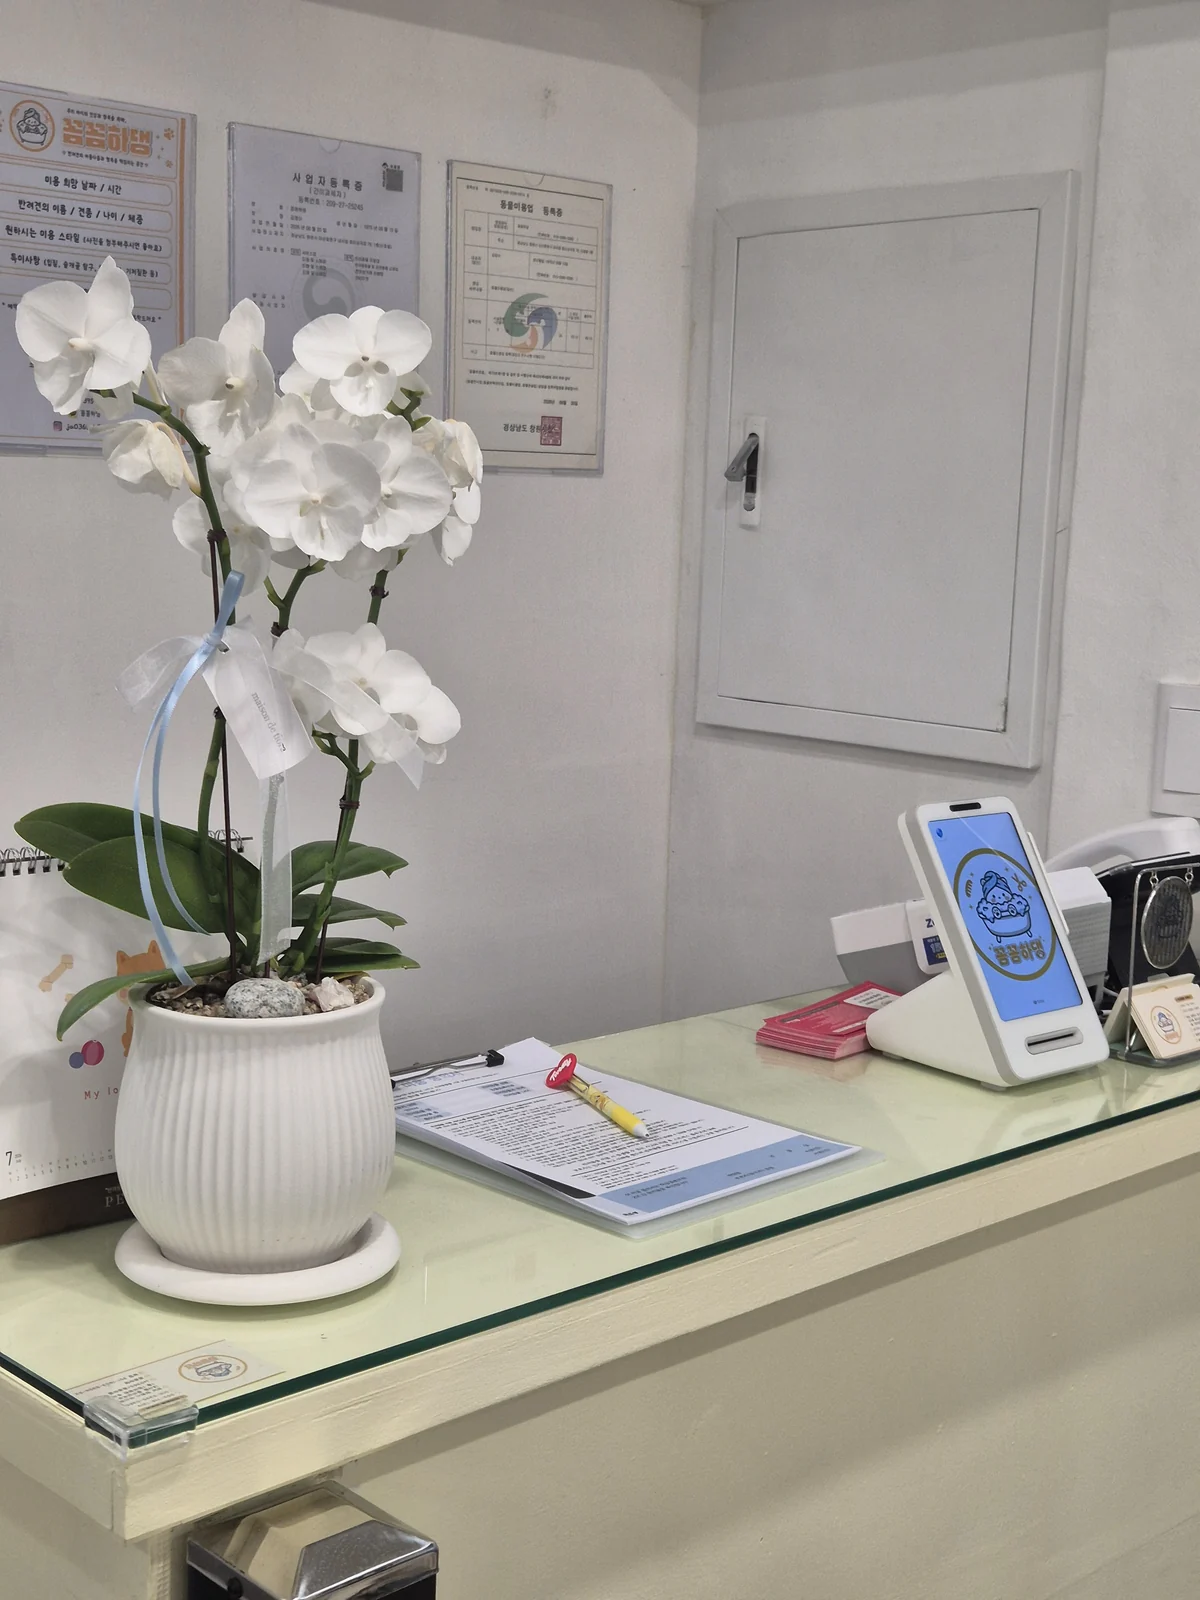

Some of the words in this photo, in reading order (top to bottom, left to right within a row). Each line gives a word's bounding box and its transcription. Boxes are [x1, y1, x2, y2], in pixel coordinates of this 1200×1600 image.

[62, 117, 153, 158] 꼼꼼하댕
[44, 175, 61, 187] 미용
[63, 177, 79, 190] 희망
[81, 179, 97, 192] 날짜
[107, 184, 122, 196] 시간
[292, 172, 363, 191] 사업자등록증
[18, 199, 50, 213] 반려견의
[52, 203, 67, 215] 이름
[78, 206, 93, 219] 견종
[103, 211, 118, 221] 나이
[128, 213, 144, 225] 체중
[5, 224, 37, 239] 원하시는
[40, 229, 55, 241] 미용
[58, 232, 80, 244] 스타일
[10, 252, 41, 266] 특이사항
[503, 423, 528, 433] 경상남도
[251, 691, 271, 722] maison
[267, 721, 278, 734] de
[84, 1089, 101, 1101] My
[107, 1086, 120, 1096] lo
[5, 1150, 13, 1167] 7
[104, 1193, 126, 1208] PE
